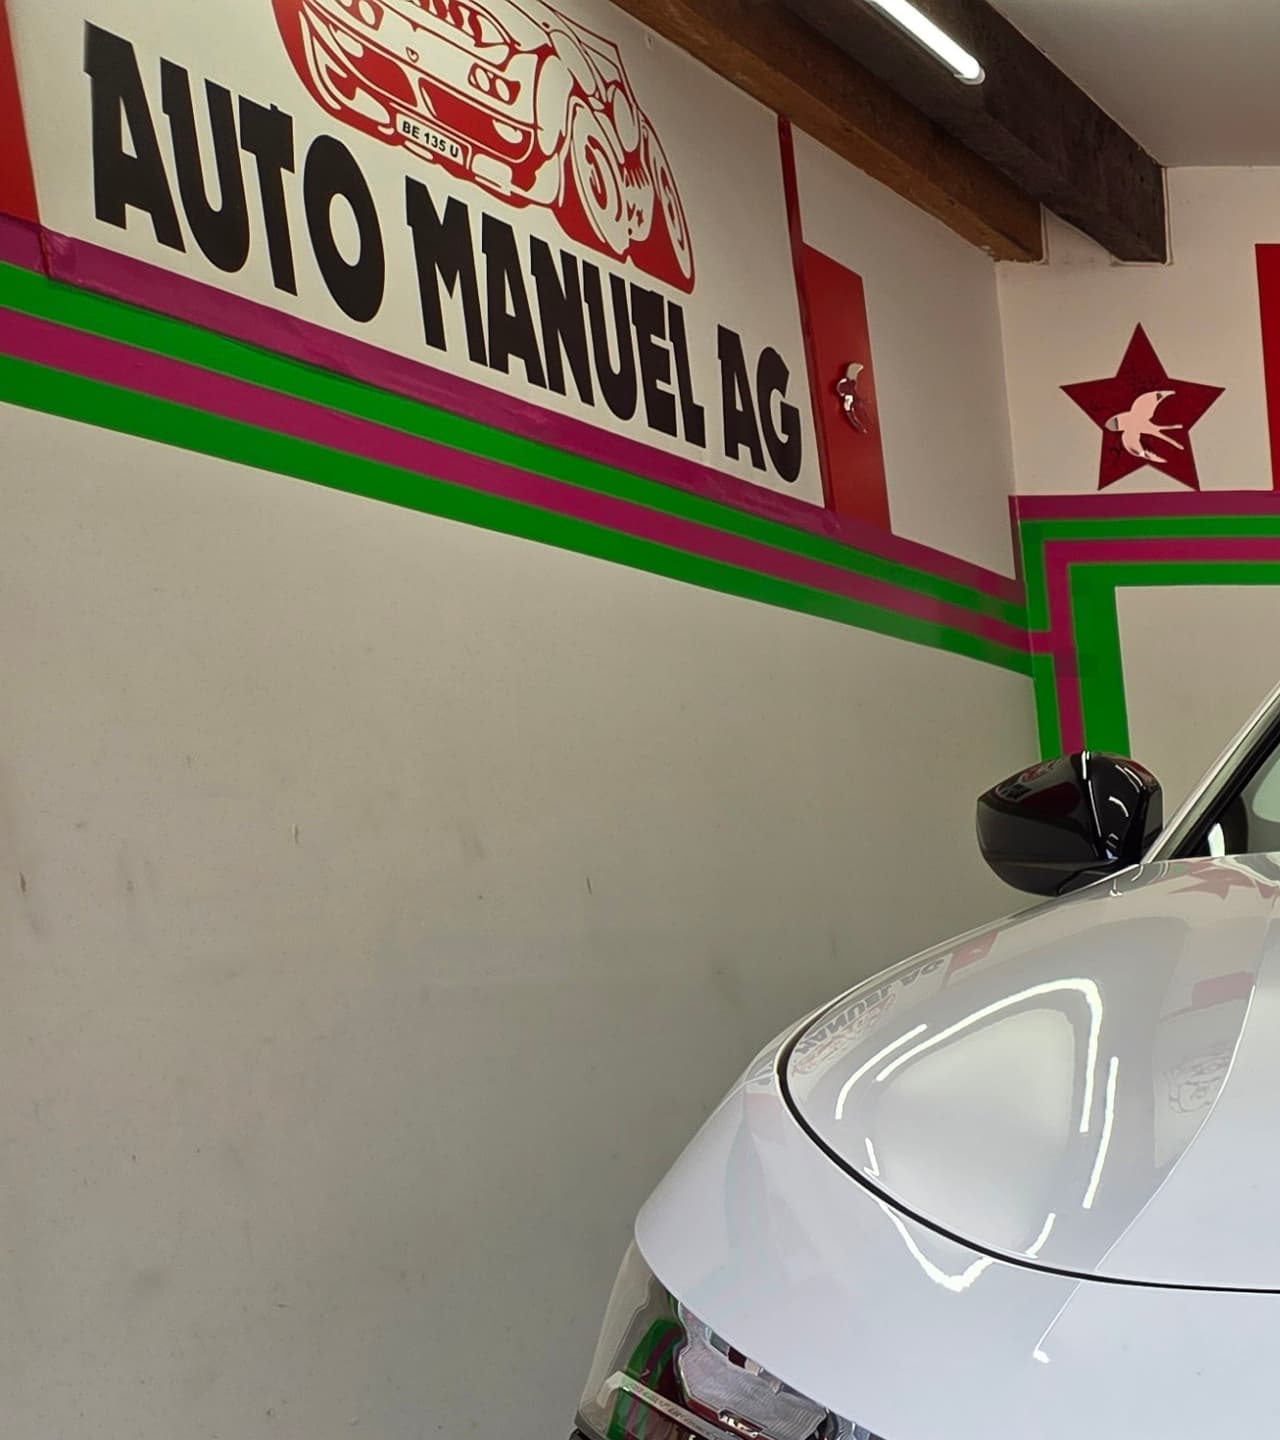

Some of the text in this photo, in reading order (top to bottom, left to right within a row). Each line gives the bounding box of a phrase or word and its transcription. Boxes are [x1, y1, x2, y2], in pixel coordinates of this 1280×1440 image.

[84, 21, 803, 483] AUTO MANUEL AG
[402, 120, 459, 158] BE 135 U
